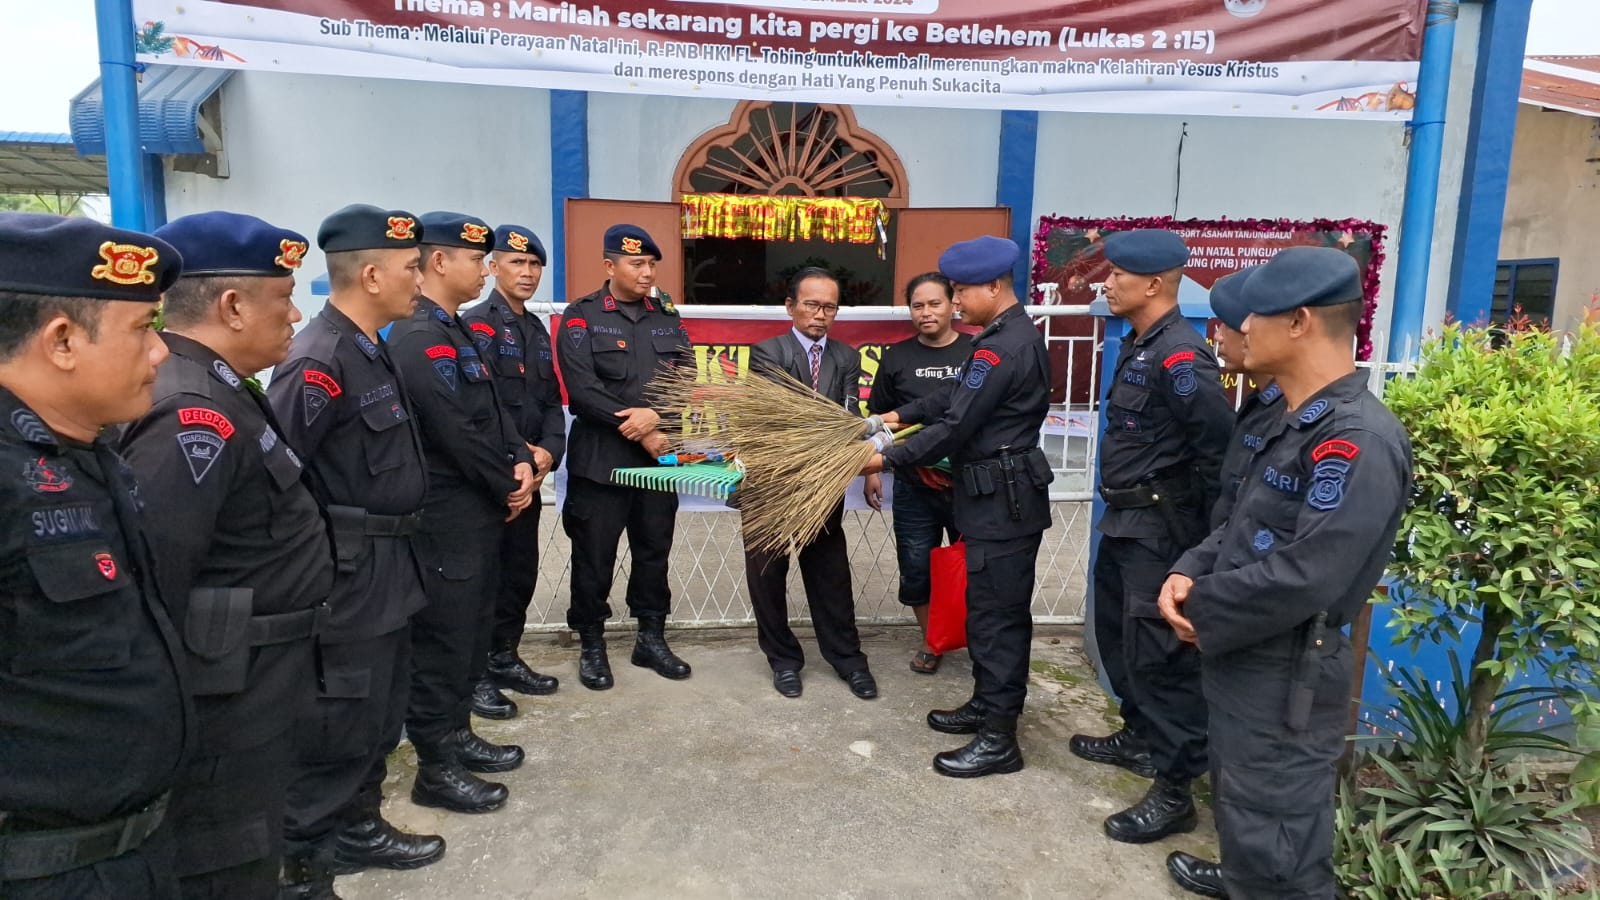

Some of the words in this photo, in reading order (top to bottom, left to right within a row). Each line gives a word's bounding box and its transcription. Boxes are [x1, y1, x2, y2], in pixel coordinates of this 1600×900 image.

[395, 0, 484, 17] Thema
[493, 3, 499, 18] :
[509, 1, 610, 26] Marilah
[618, 9, 742, 38] sekarang
[750, 13, 801, 37] kita
[810, 18, 880, 45] pergi
[886, 20, 918, 42] ke
[926, 22, 1051, 47] Betlehem
[1058, 26, 1145, 52] (Lukas
[1152, 30, 1167, 49] 2
[1174, 30, 1215, 54] :15)
[320, 19, 350, 36] Sub
[356, 21, 410, 40] Thema
[424, 25, 484, 44] Melalui
[490, 30, 565, 51] Perayaan
[570, 35, 613, 54] Natal
[618, 39, 642, 58] ini,
[703, 44, 731, 61] HKI
[736, 46, 757, 63] FL.
[762, 48, 814, 69] Tobing
[817, 51, 862, 68] untuk
[866, 51, 928, 70] kembali
[932, 57, 1038, 75] merenungkan
[1043, 60, 1095, 74] makna
[1100, 60, 1175, 75] Kelahiran
[1180, 61, 1222, 77] Yesus
[1226, 62, 1279, 78] Kristus
[614, 62, 643, 77] dan
[648, 67, 734, 84] merespons
[739, 69, 797, 88] dengan
[802, 72, 834, 87] Hati
[838, 74, 875, 92] Yang
[879, 76, 927, 91] Penuh
[932, 78, 1000, 94] Sukacita
[1206, 246, 1236, 257] NATAL
[1238, 247, 1282, 258] PUNGUA
[1210, 258, 1239, 270] (PNB)
[915, 366, 943, 379] Thug
[1124, 370, 1146, 385] POLRI
[1264, 466, 1299, 492] POLRI
